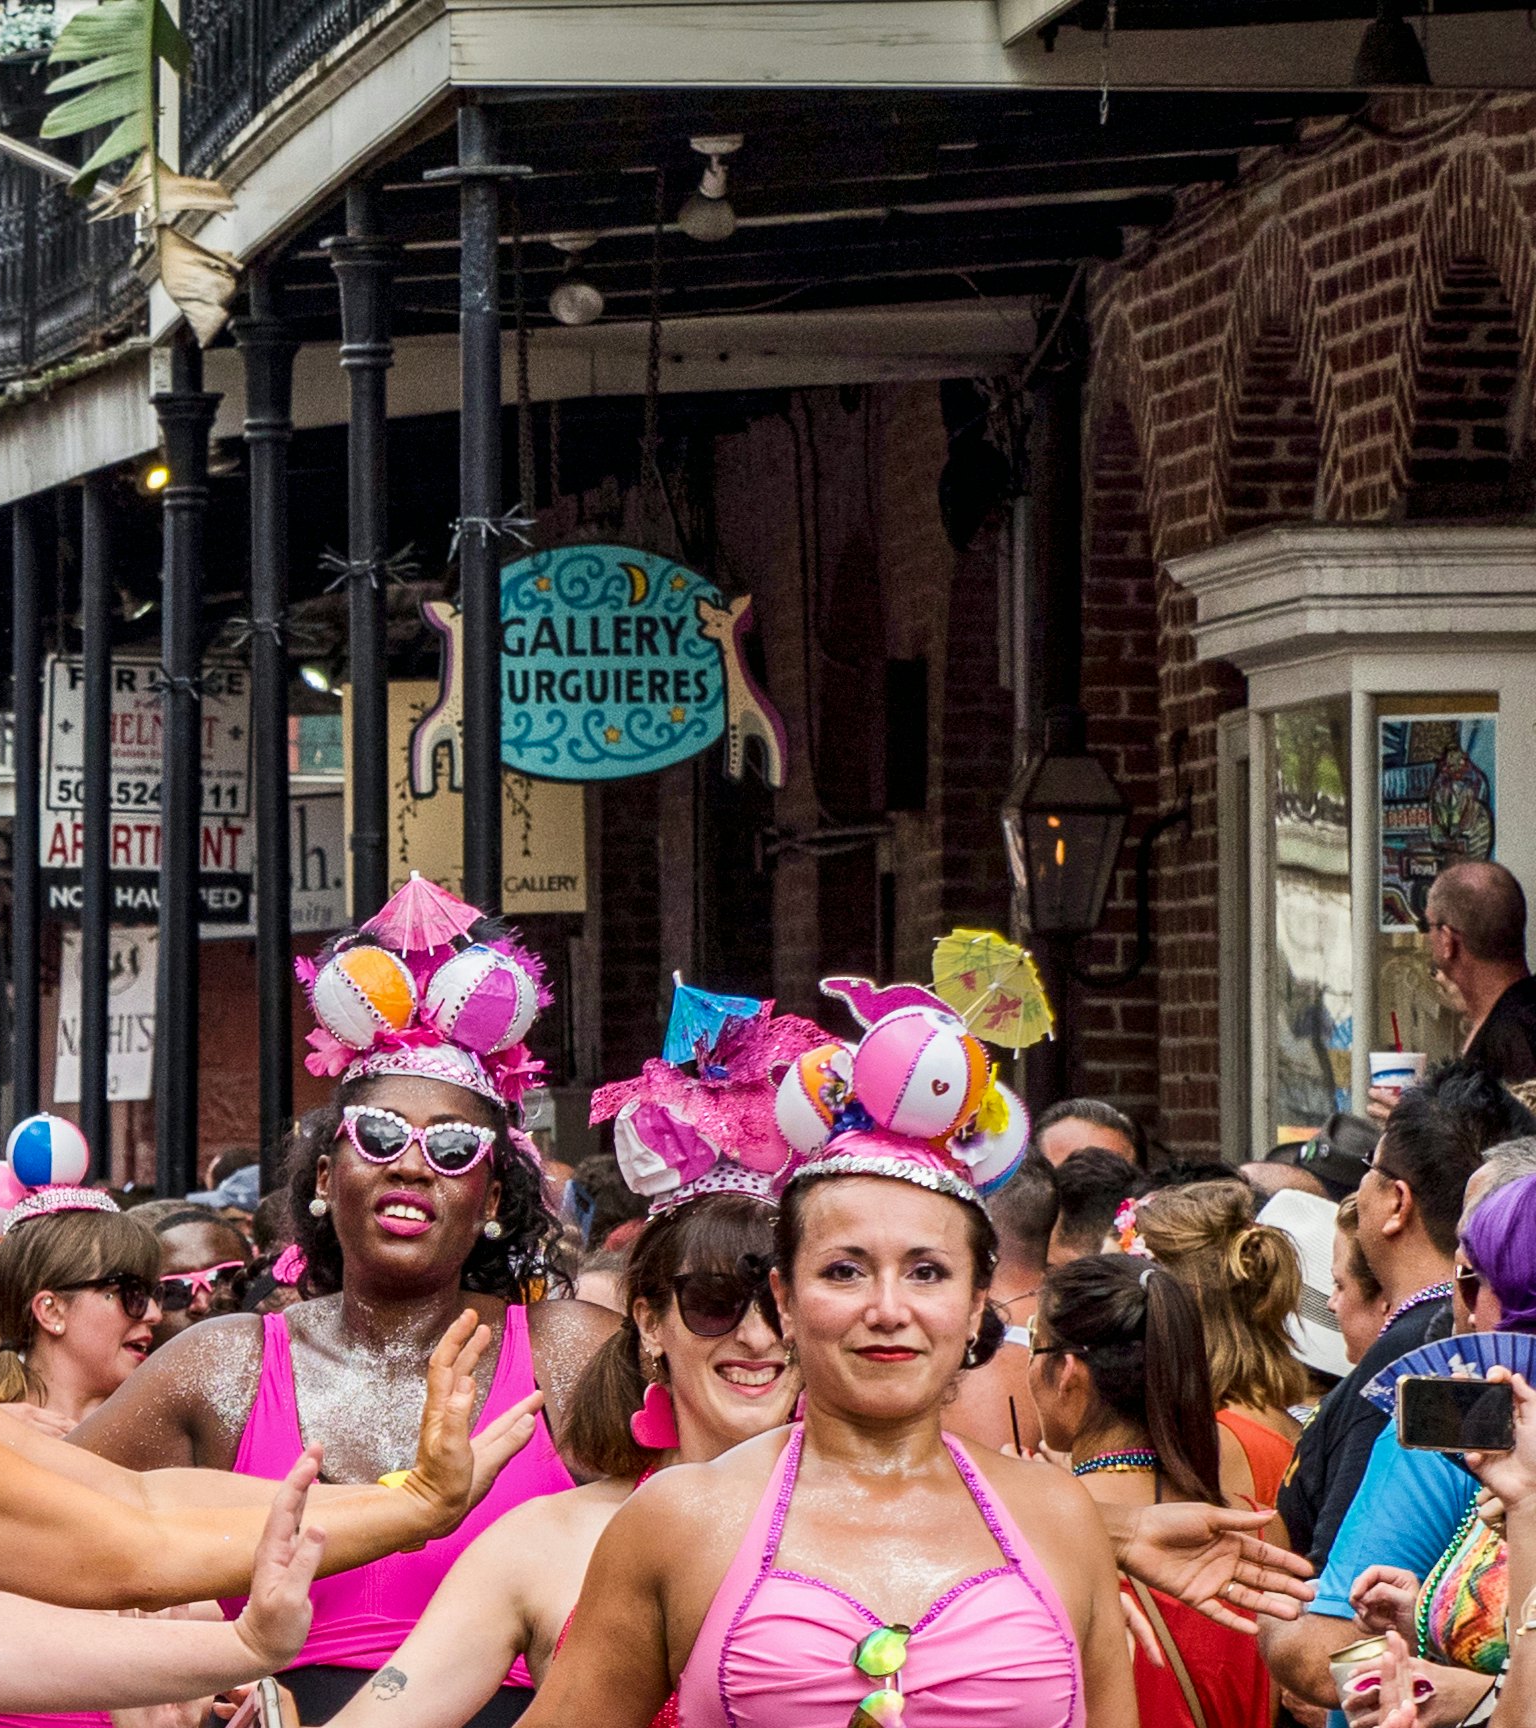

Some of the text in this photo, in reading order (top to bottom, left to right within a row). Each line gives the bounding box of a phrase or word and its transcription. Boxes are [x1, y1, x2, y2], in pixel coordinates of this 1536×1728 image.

[501, 616, 688, 656] GALLERY
[508, 669, 708, 704] URGUIERES
[504, 874, 577, 893] GALLERY
